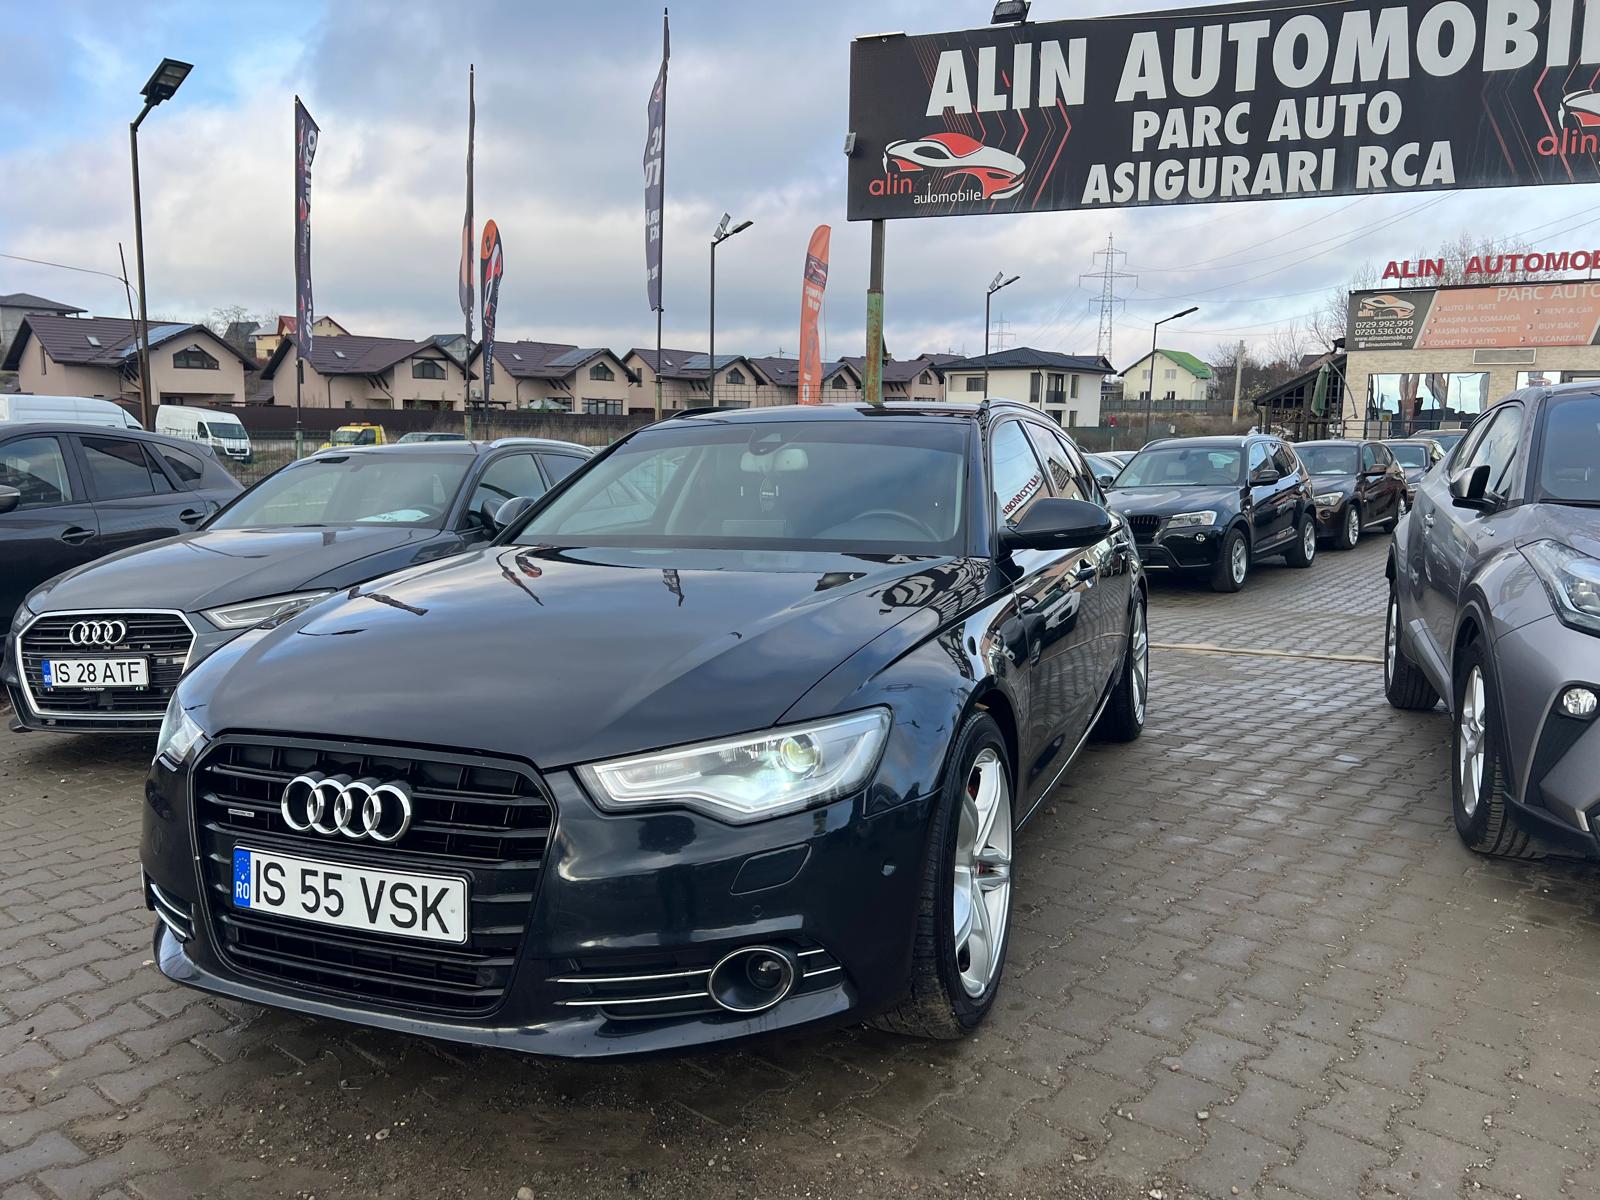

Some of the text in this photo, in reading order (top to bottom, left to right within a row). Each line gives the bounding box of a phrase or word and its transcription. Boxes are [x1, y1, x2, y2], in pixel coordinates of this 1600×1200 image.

[926, 37, 1087, 117] ALIN
[1132, 90, 1403, 152] PARC AUTO
[1537, 127, 1598, 156] alin
[868, 172, 913, 196] alin
[1080, 140, 1456, 204] ASIGURARI RCA
[913, 182, 982, 205] automobile
[1381, 258, 1444, 279] ALIN
[1496, 286, 1545, 302] PARC
[1355, 320, 1414, 329] 0729.992.999
[54, 662, 71, 683] IS
[76, 662, 97, 683] 28
[102, 661, 141, 683] ATF
[235, 859, 450, 934] RO IS 55 VSK
